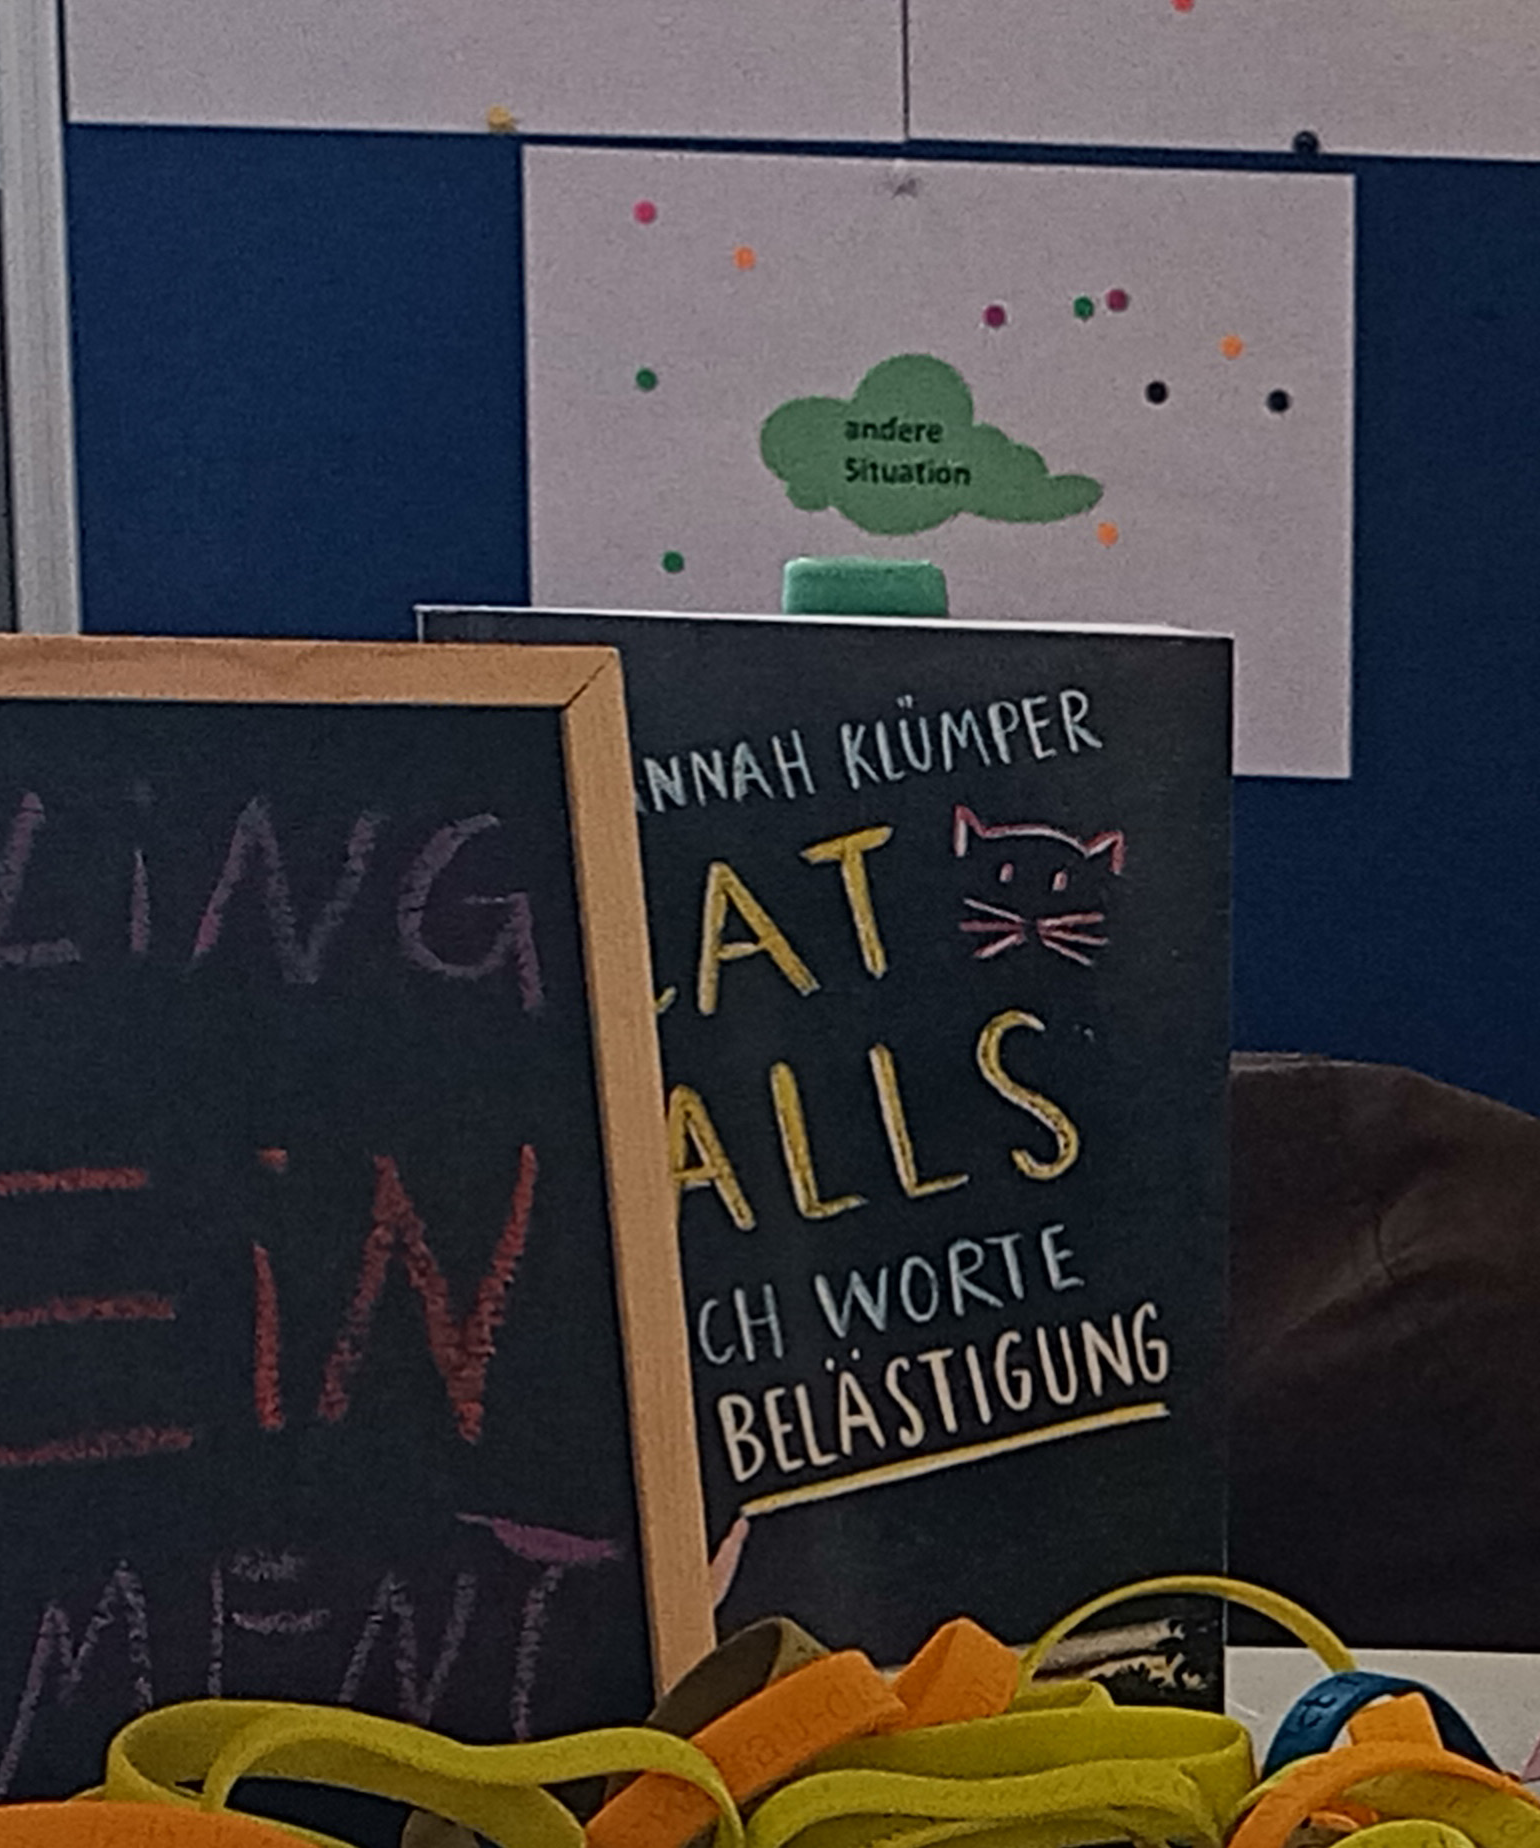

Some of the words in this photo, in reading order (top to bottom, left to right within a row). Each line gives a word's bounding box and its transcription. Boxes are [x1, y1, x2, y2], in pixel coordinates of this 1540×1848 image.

[844, 416, 943, 445] andere
[844, 457, 971, 488] Situation
[634, 728, 817, 815] NNAH
[840, 689, 1103, 790] KLÜMPER
[655, 825, 894, 1016] AT
[666, 1009, 1080, 1231] ALLS
[697, 1281, 784, 1366] CH
[814, 1224, 1086, 1340] WORTE
[716, 1302, 1170, 1484] BELÄSTIGUNG
